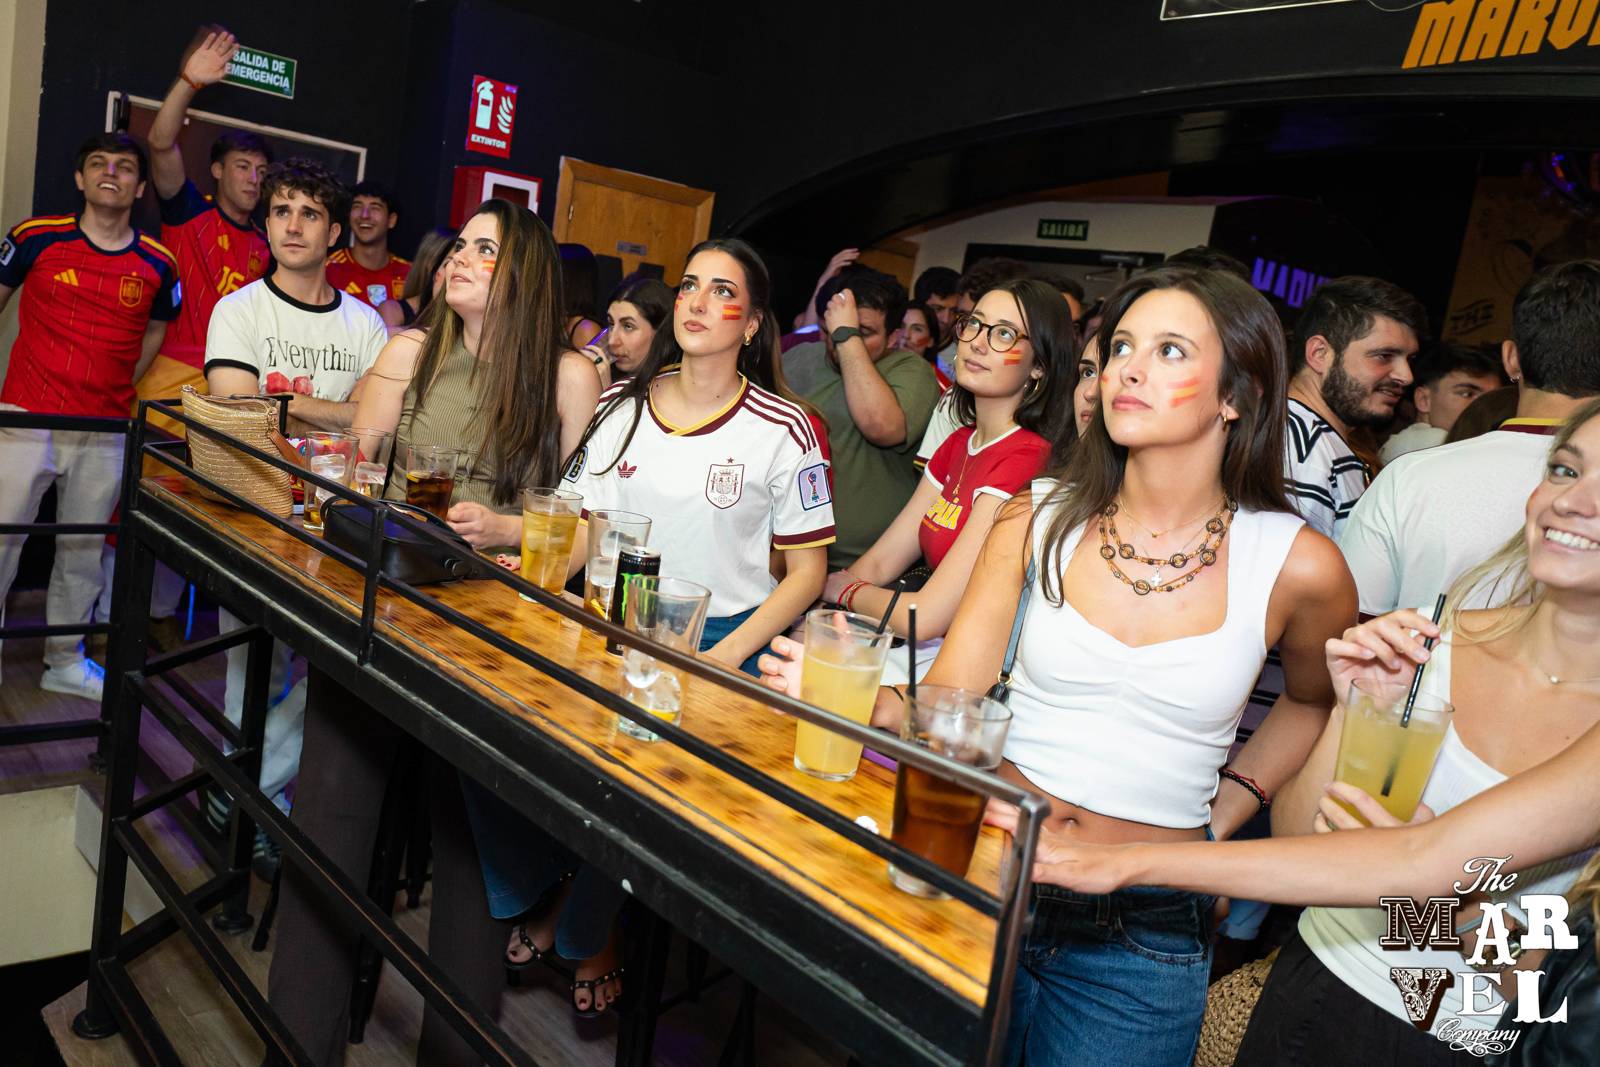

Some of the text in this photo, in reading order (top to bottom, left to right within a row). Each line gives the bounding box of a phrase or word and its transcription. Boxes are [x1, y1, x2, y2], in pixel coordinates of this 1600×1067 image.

[1402, 0, 1600, 69] MARV
[225, 62, 290, 89] EMERGENCIA
[233, 50, 286, 74] SALIDA DE
[265, 336, 357, 380] Everythin
